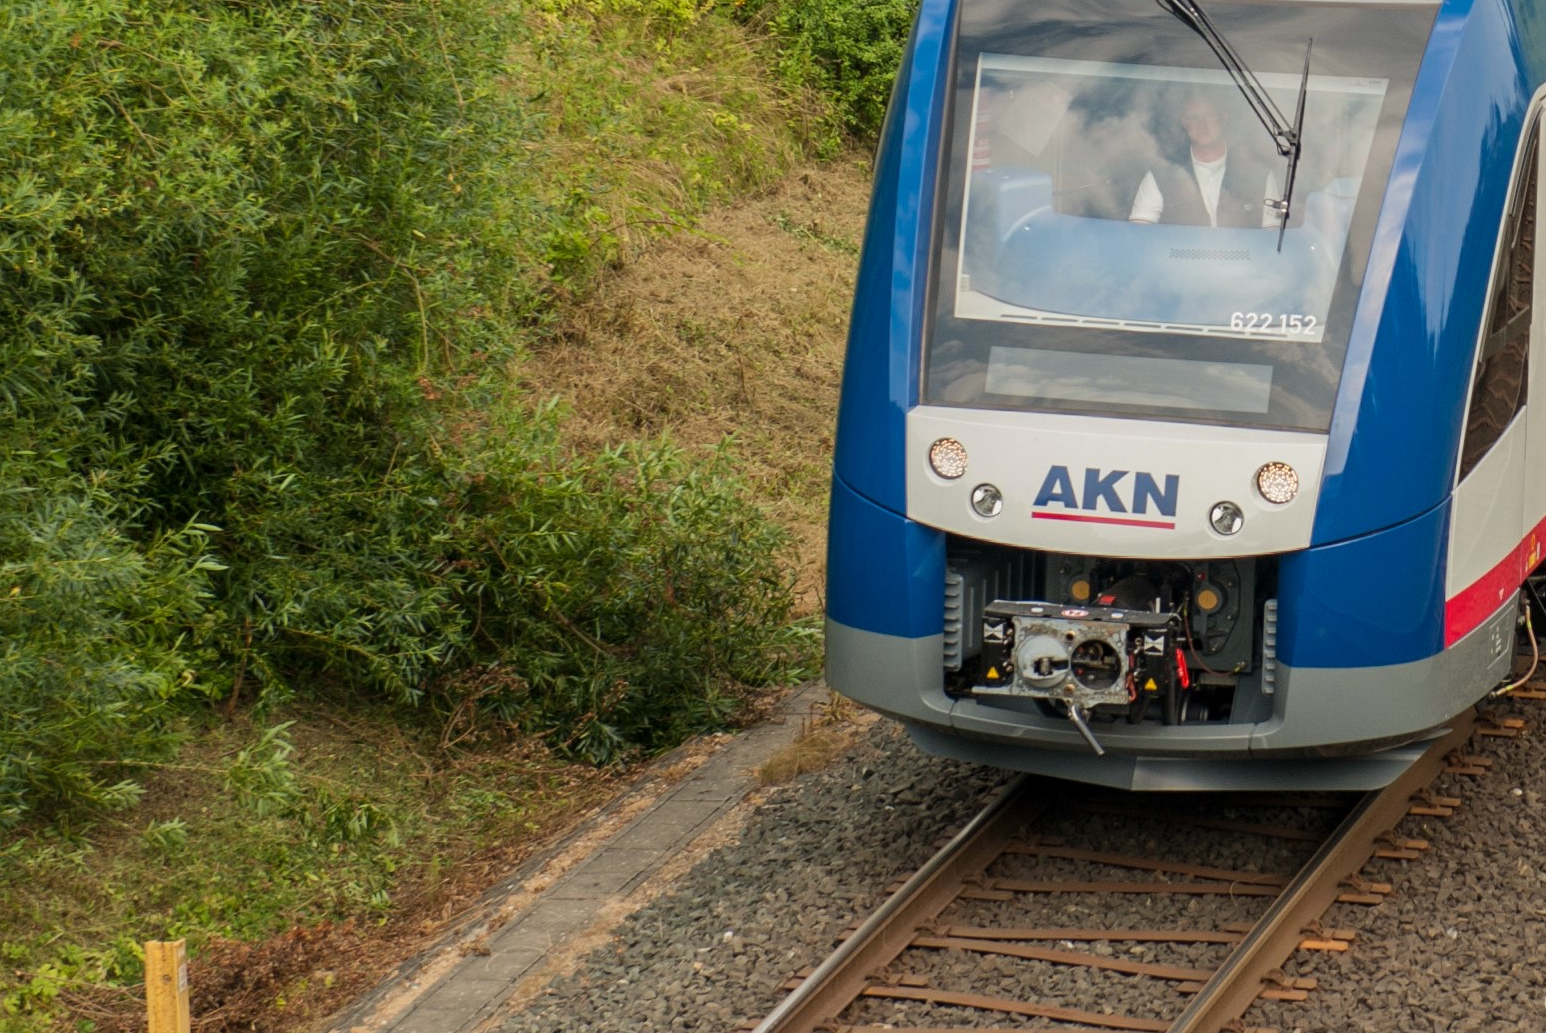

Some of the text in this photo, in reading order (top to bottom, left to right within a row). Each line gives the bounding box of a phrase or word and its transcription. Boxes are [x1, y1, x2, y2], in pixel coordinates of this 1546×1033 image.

[1230, 311, 1317, 336] 622 152
[1032, 464, 1180, 518] AKN
